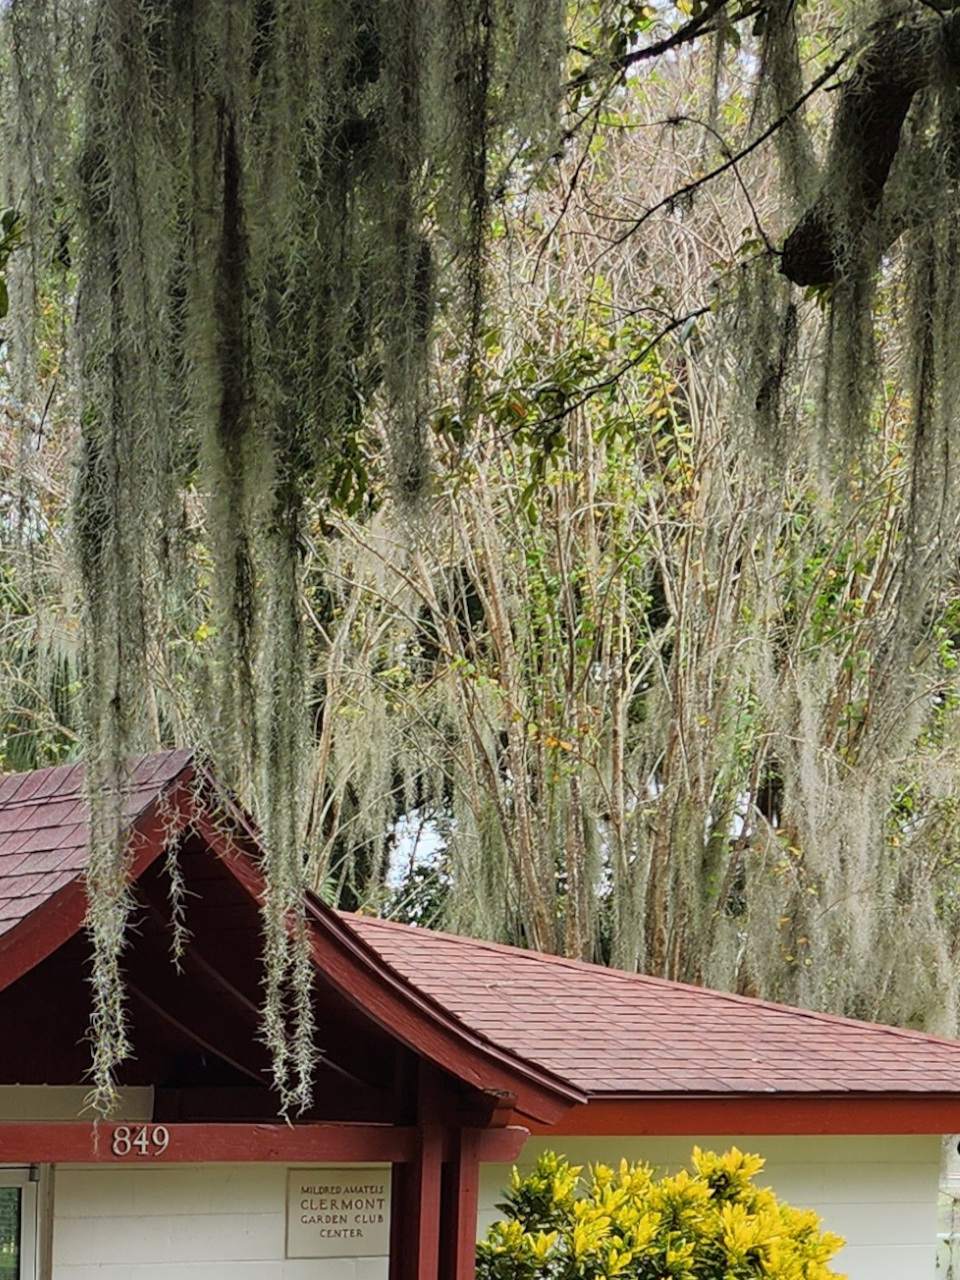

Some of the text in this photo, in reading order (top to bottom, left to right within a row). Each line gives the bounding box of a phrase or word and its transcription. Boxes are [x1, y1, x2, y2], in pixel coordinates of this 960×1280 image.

[112, 1125, 170, 1156] 849
[301, 1185, 384, 1195] MILDRED AMATEIS
[300, 1198, 385, 1211] CLERMONT
[300, 1214, 384, 1224] GARDEN CLUB
[320, 1229, 364, 1238] CENTER
